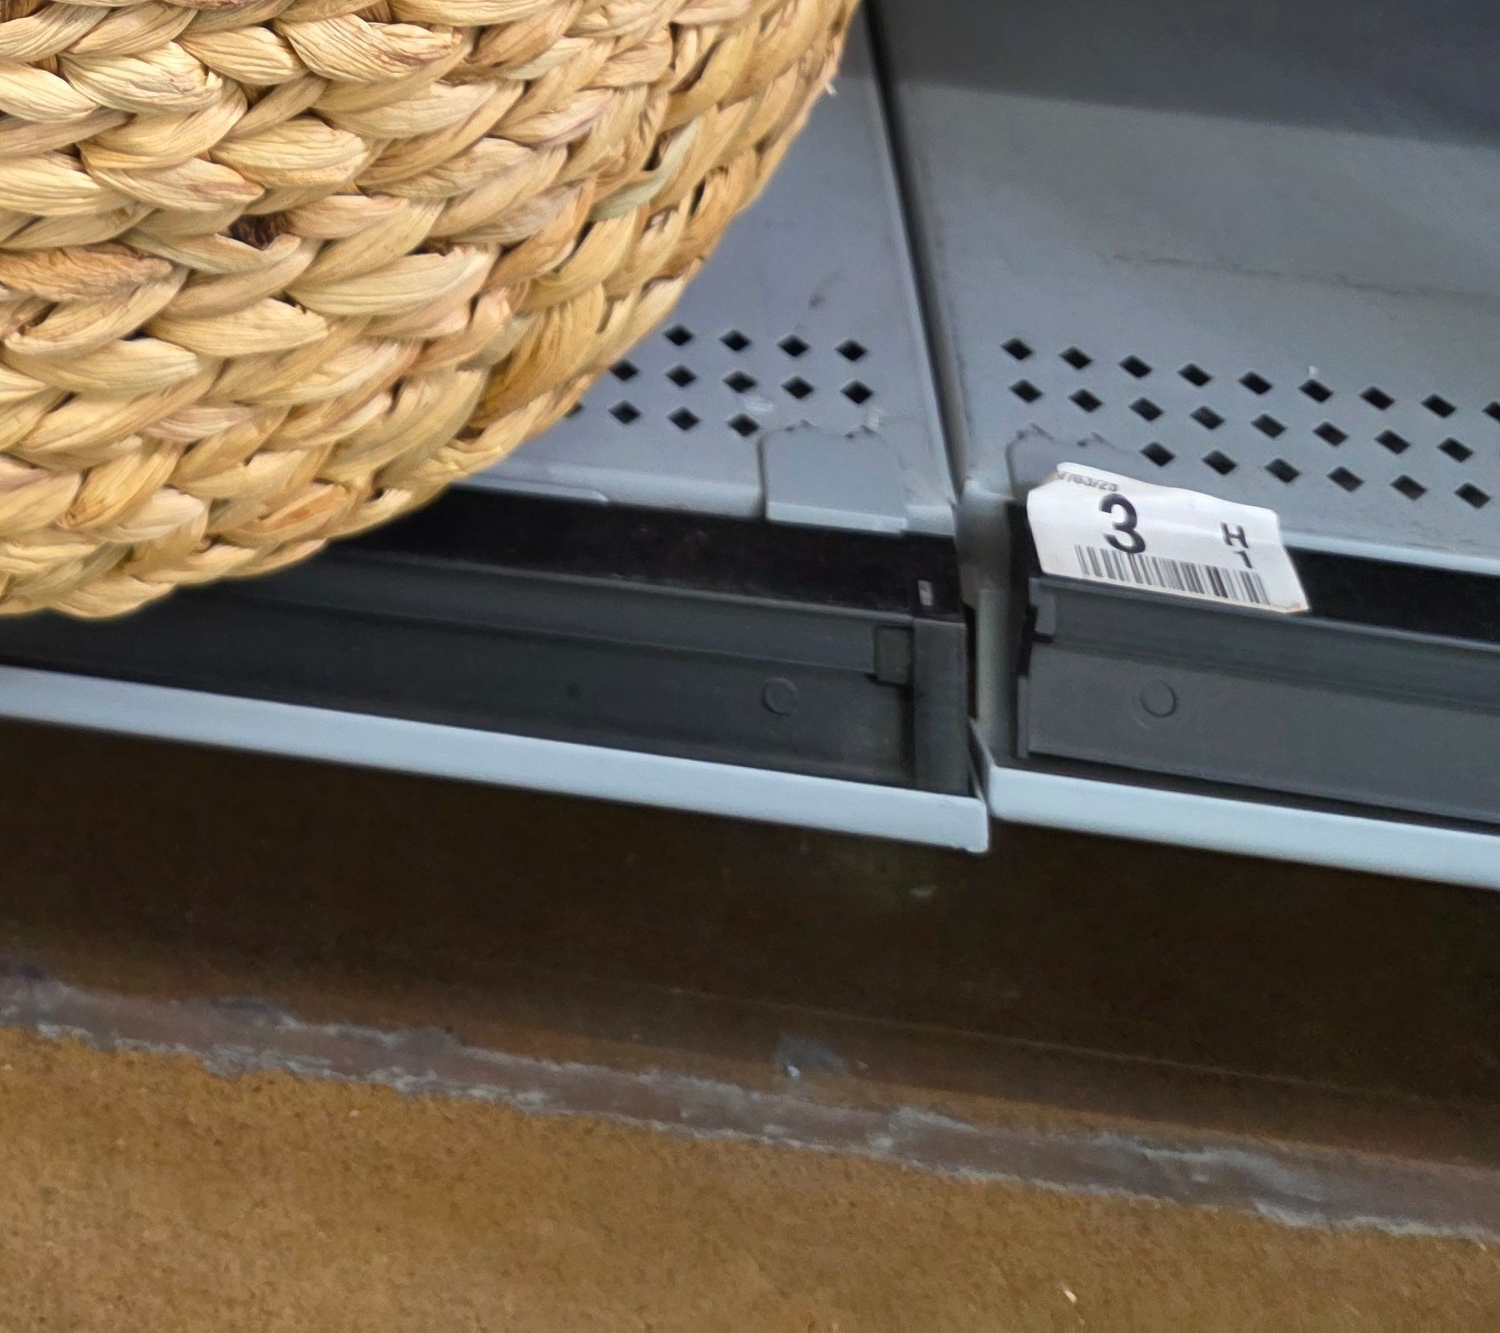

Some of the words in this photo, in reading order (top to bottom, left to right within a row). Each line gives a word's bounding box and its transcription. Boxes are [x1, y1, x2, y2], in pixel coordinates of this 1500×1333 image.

[1099, 493, 1146, 554] 3
[1220, 521, 1249, 550] H
[1234, 550, 1253, 569] 1
